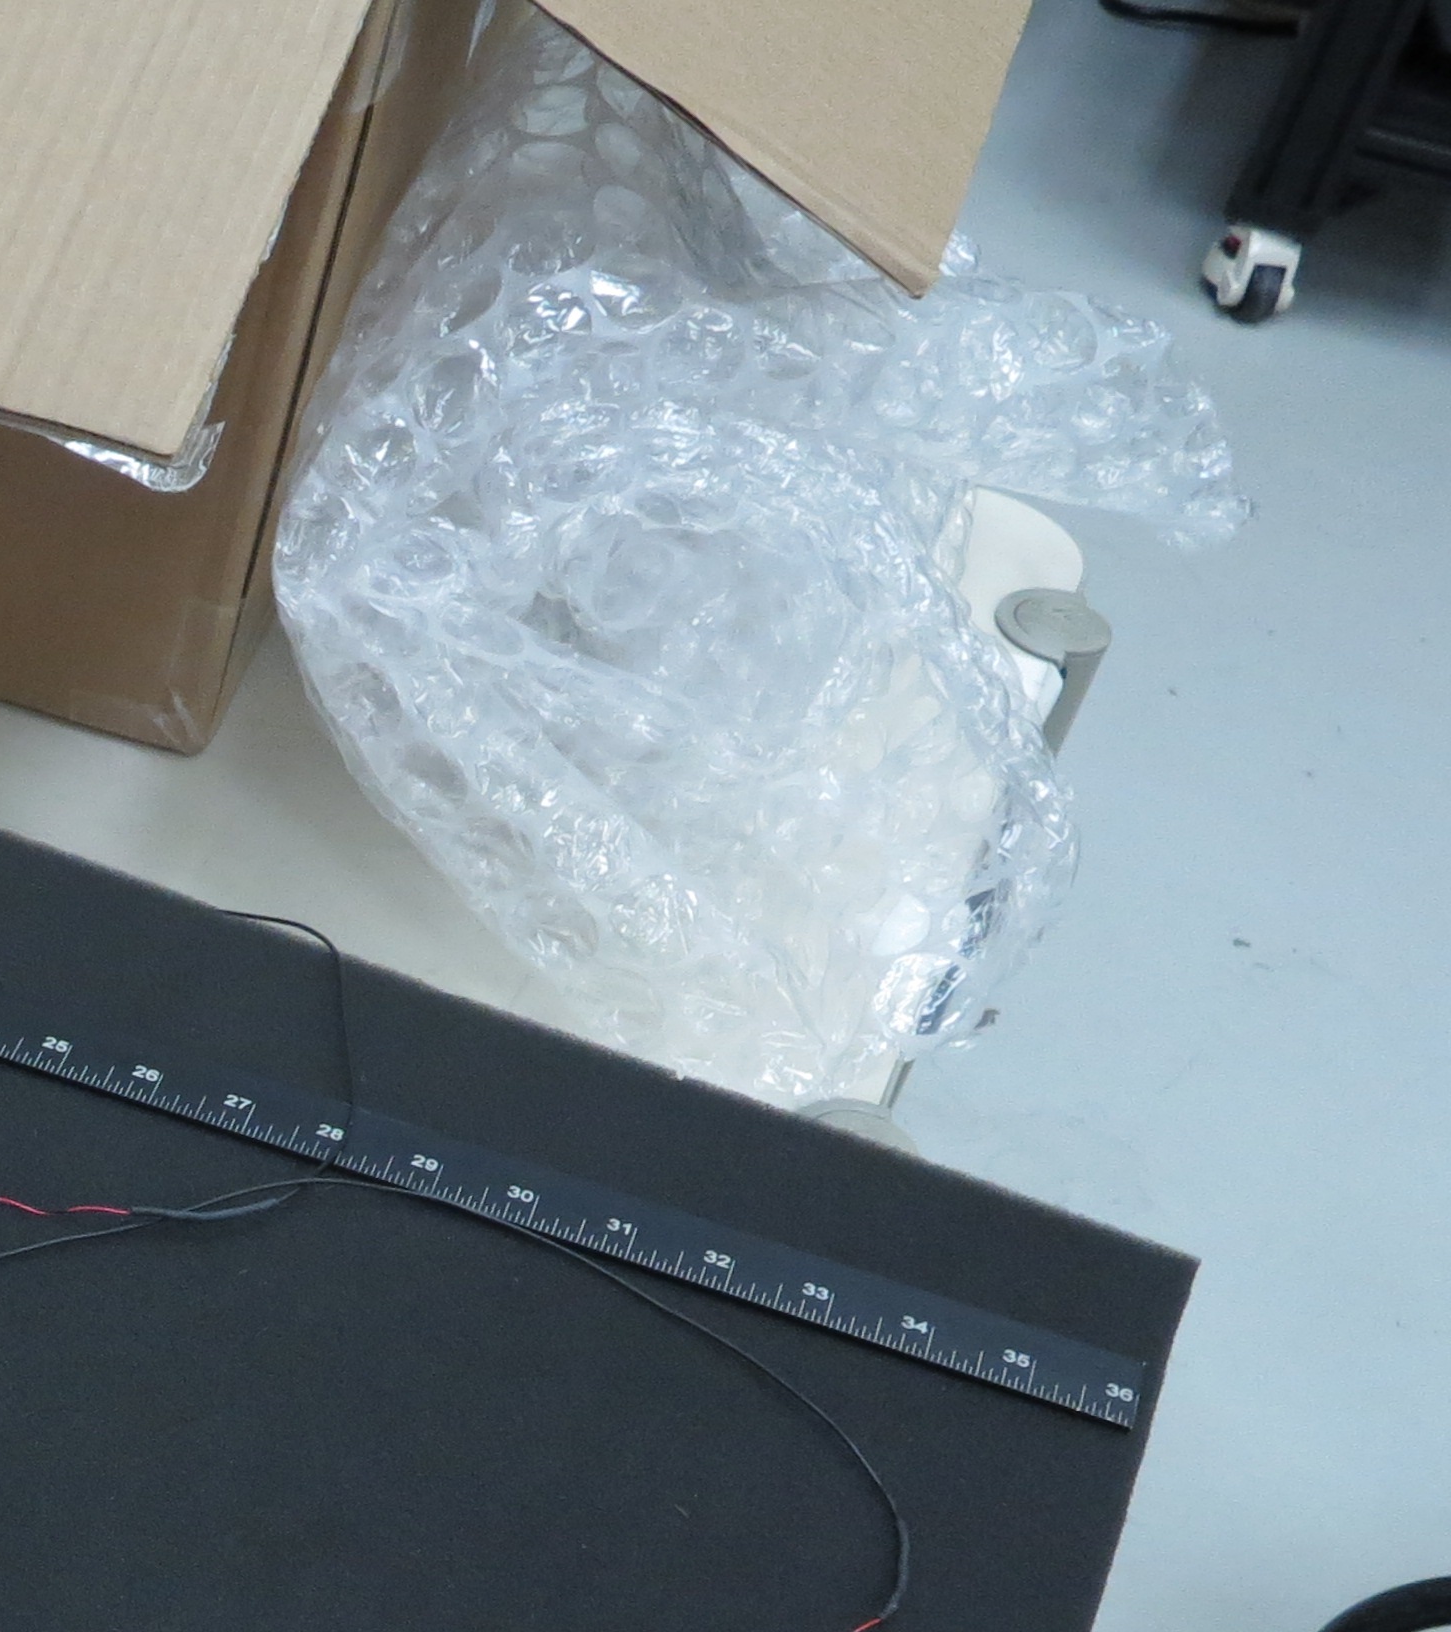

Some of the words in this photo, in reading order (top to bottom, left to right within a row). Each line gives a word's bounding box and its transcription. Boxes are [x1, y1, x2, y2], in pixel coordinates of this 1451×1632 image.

[43, 1036, 70, 1053] 25
[132, 1065, 160, 1082] 26
[224, 1093, 253, 1110] 27
[315, 1124, 344, 1141] 28
[410, 1154, 440, 1172] 29
[507, 1184, 536, 1203] 30
[607, 1217, 634, 1234] 31
[703, 1251, 733, 1269] 32
[801, 1283, 831, 1301] 33
[901, 1317, 931, 1335] 34
[1002, 1349, 1032, 1367] 35
[1104, 1383, 1134, 1401] 36
